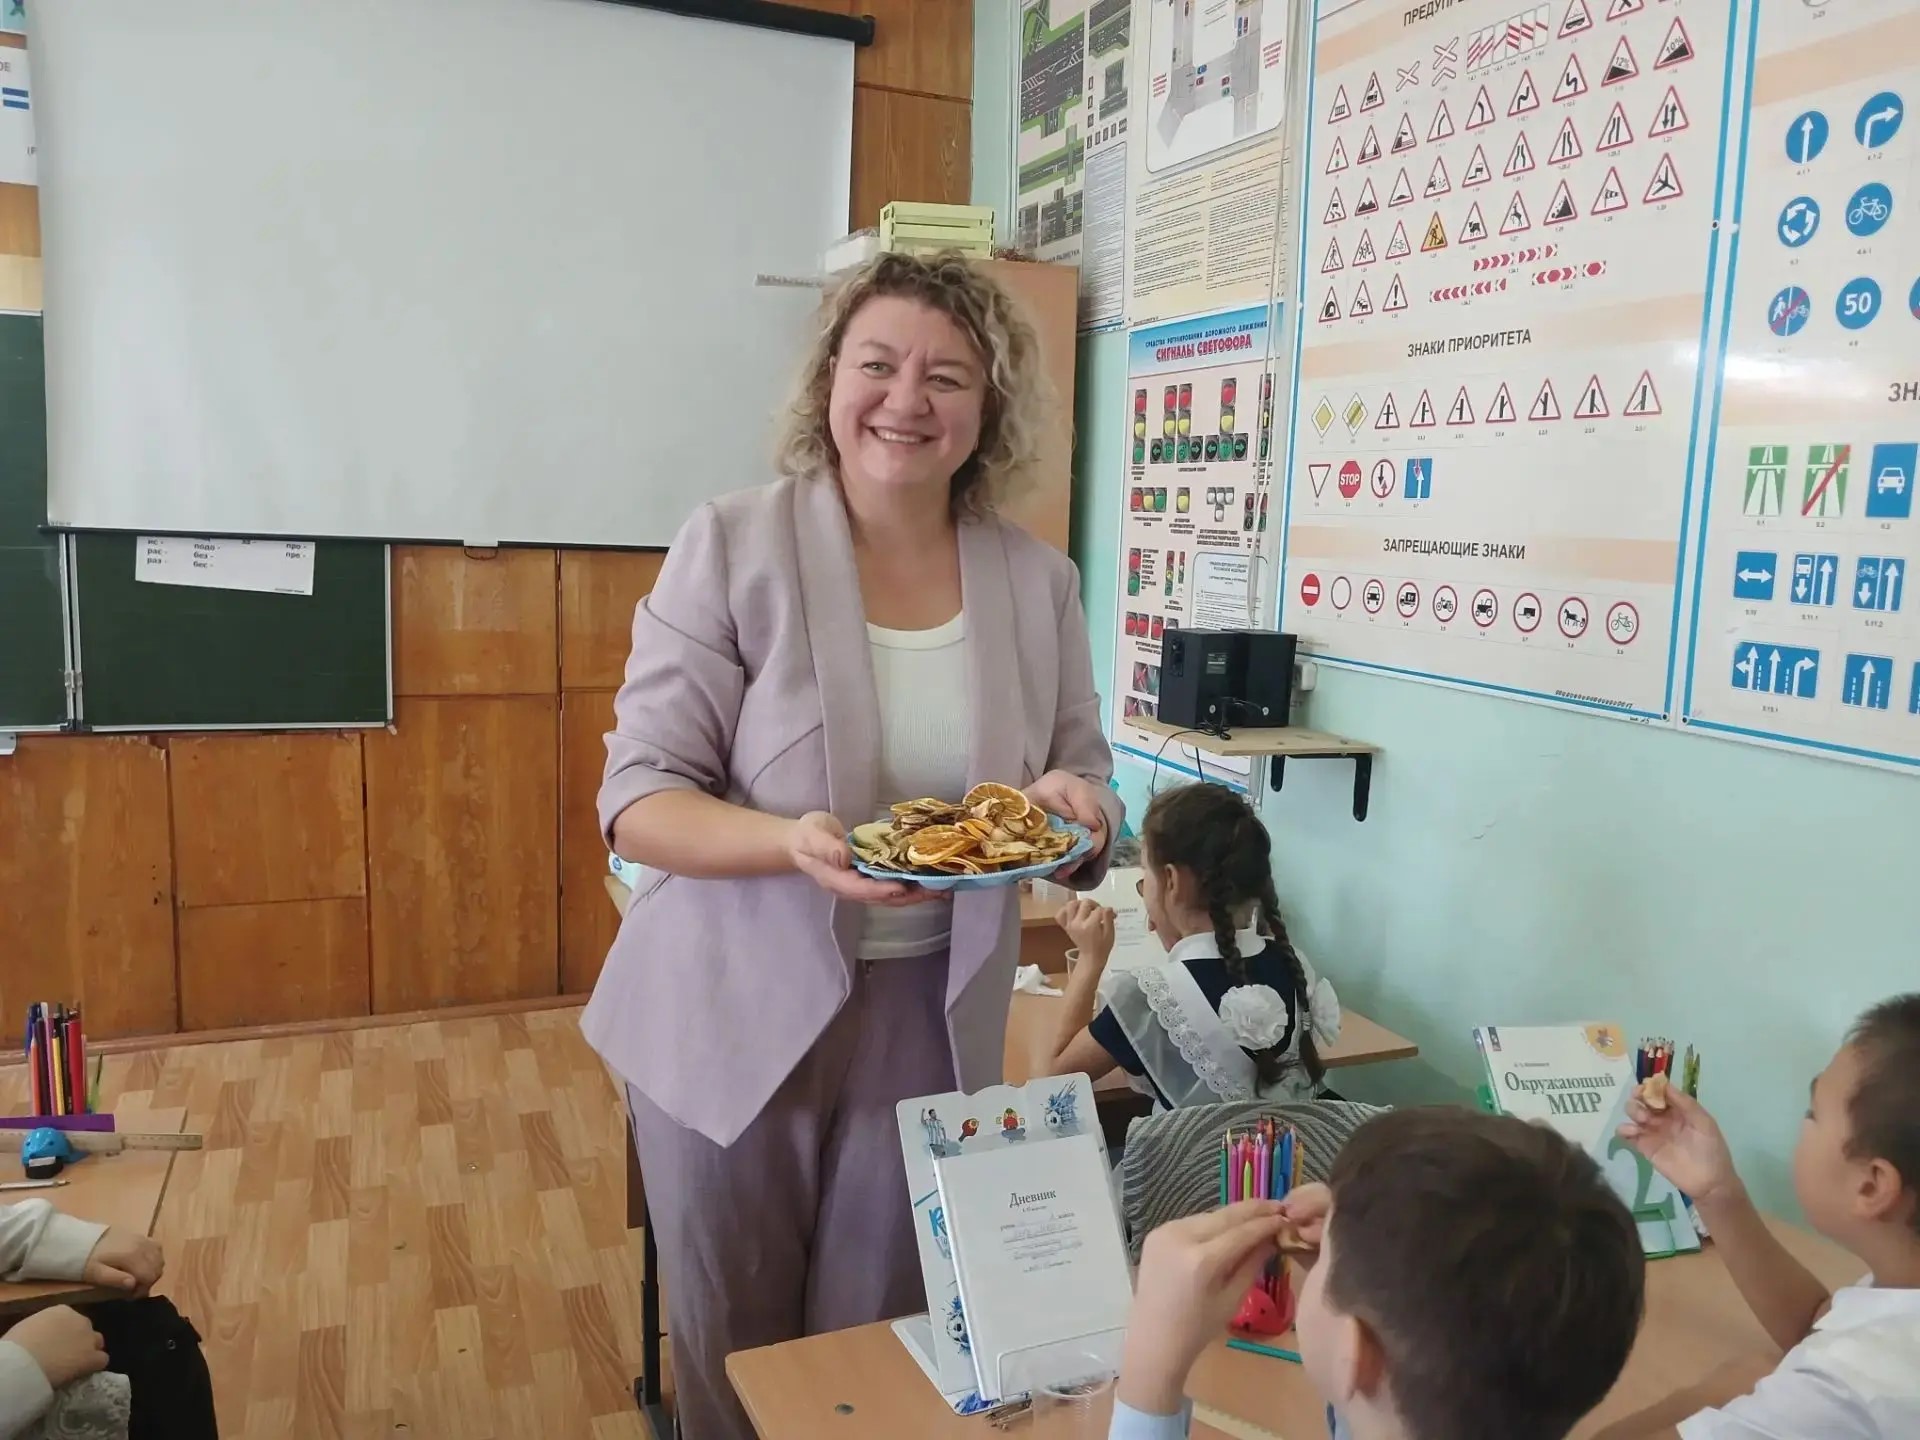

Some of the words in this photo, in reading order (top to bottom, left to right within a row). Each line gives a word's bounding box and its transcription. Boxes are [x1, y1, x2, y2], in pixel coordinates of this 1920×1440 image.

[1844, 291, 1872, 316] 50
[1204, 326, 1237, 338] ДОРОЖНОГО
[1238, 320, 1268, 332] ДВИЖЕНИЯ
[1156, 342, 1195, 362] СИГНАЛЫ
[1197, 333, 1253, 357] СВЕТОФОРА
[1407, 340, 1445, 357] ЗНАКИ
[1448, 328, 1532, 353] ПРИОРИТЕТА
[1340, 474, 1360, 486] STOP
[1383, 538, 1479, 558] ЗАПРЕЩАЮЩИЕ
[1482, 543, 1526, 559] ЗНАКИ
[1505, 1071, 1616, 1094] Окружающий
[1546, 1092, 1602, 1115] МИР
[1608, 1136, 1676, 1223] 2
[1009, 1190, 1057, 1208] Дневник
